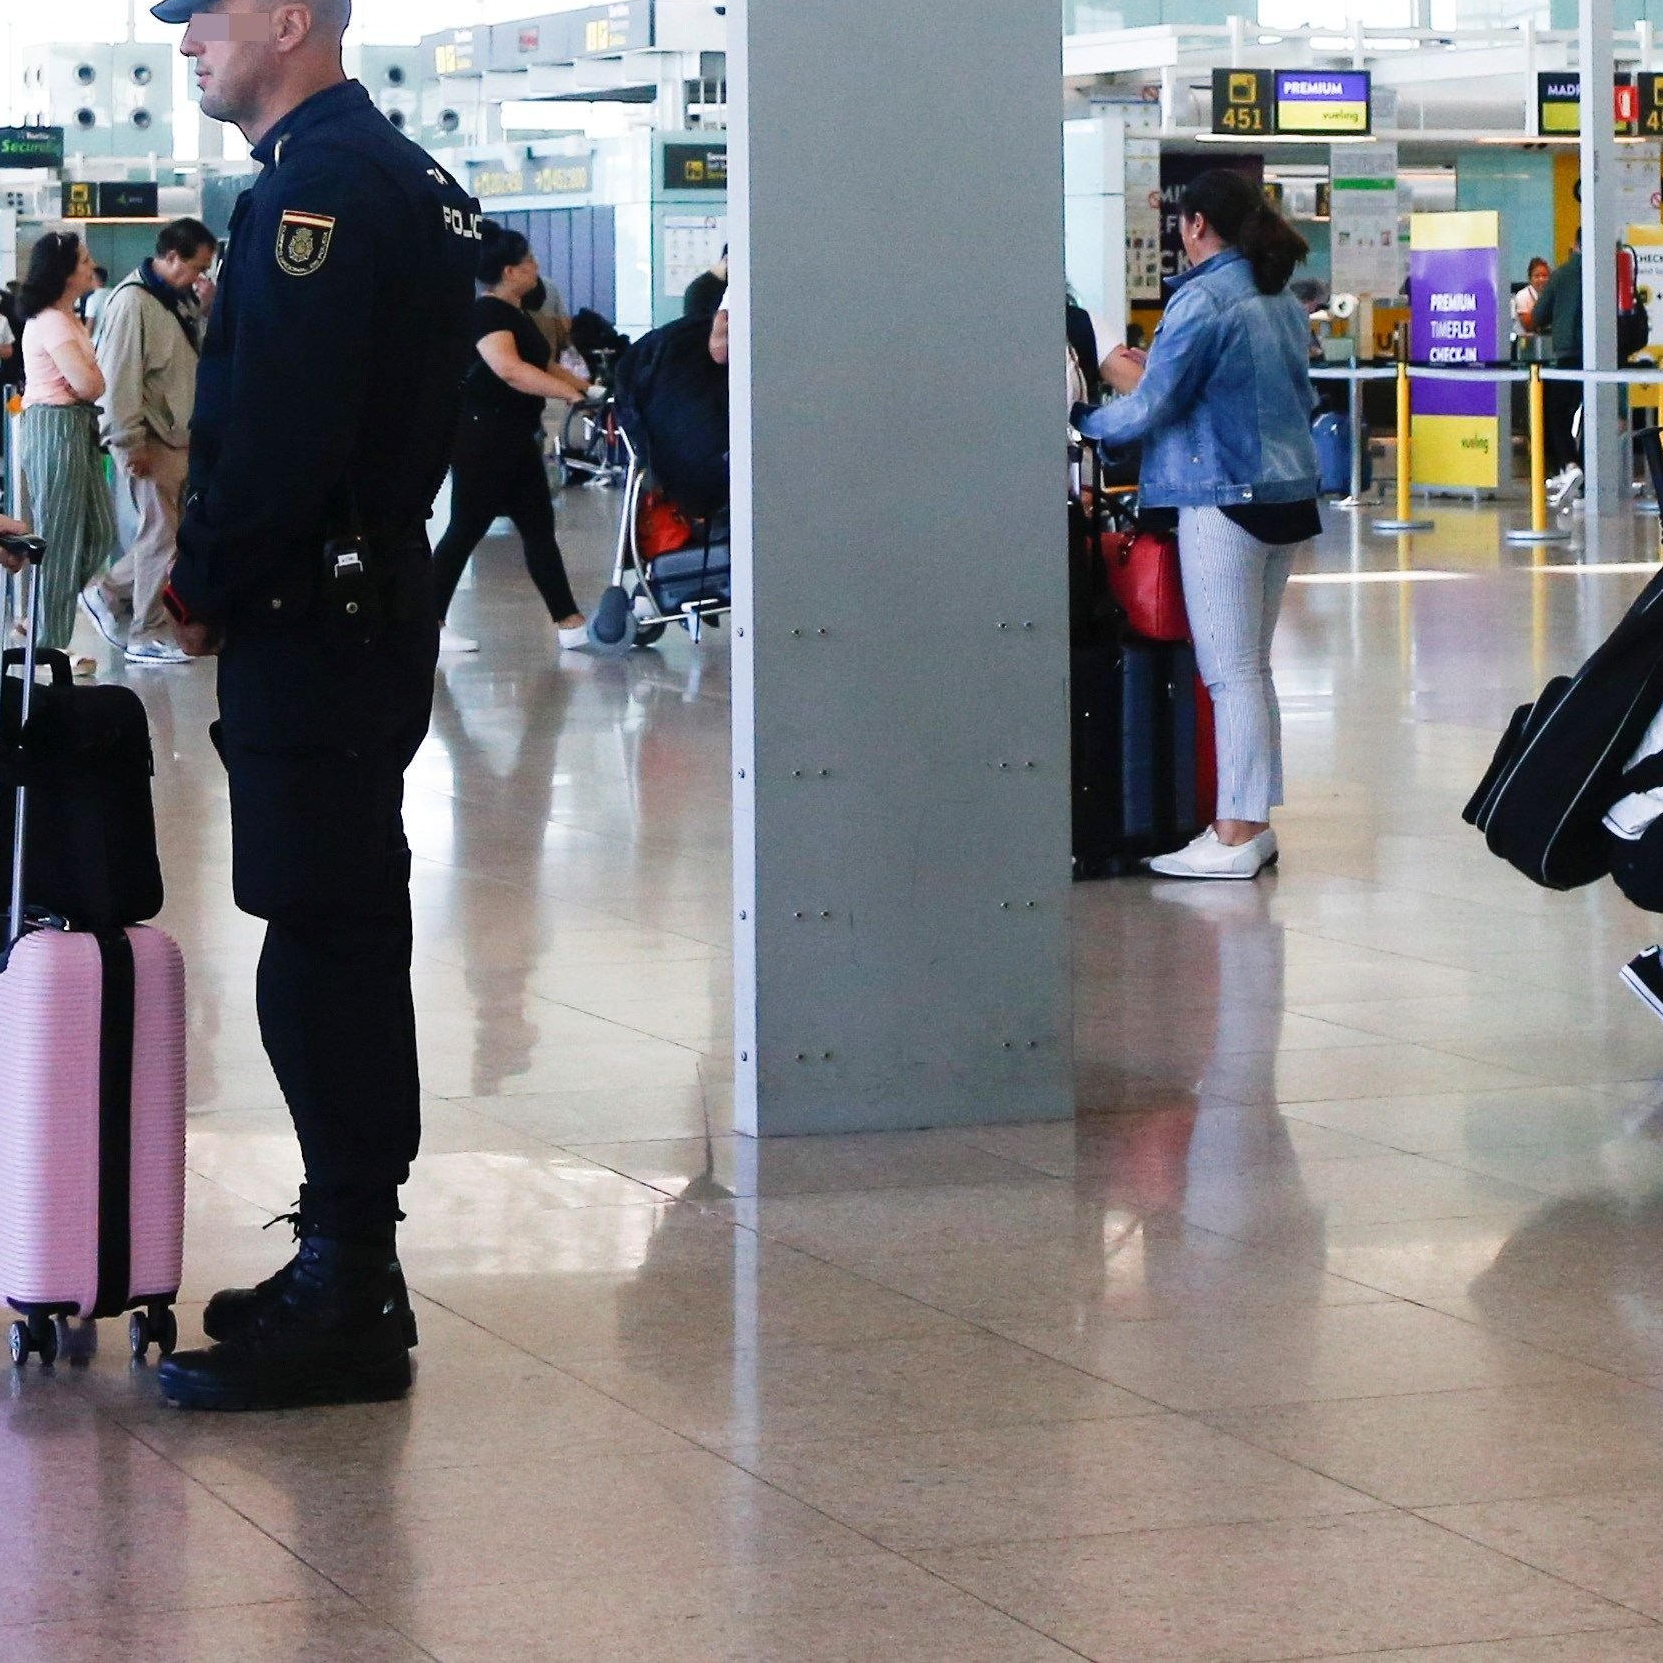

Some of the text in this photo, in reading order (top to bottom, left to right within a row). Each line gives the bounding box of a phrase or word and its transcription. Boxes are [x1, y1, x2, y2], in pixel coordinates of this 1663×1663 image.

[1283, 80, 1343, 96] PREMIUM
[1221, 108, 1263, 130] 451
[1429, 292, 1477, 312] PREMIUM
[1429, 320, 1477, 340] TIMEFLEX
[1429, 346, 1478, 363] CHECK-IN
